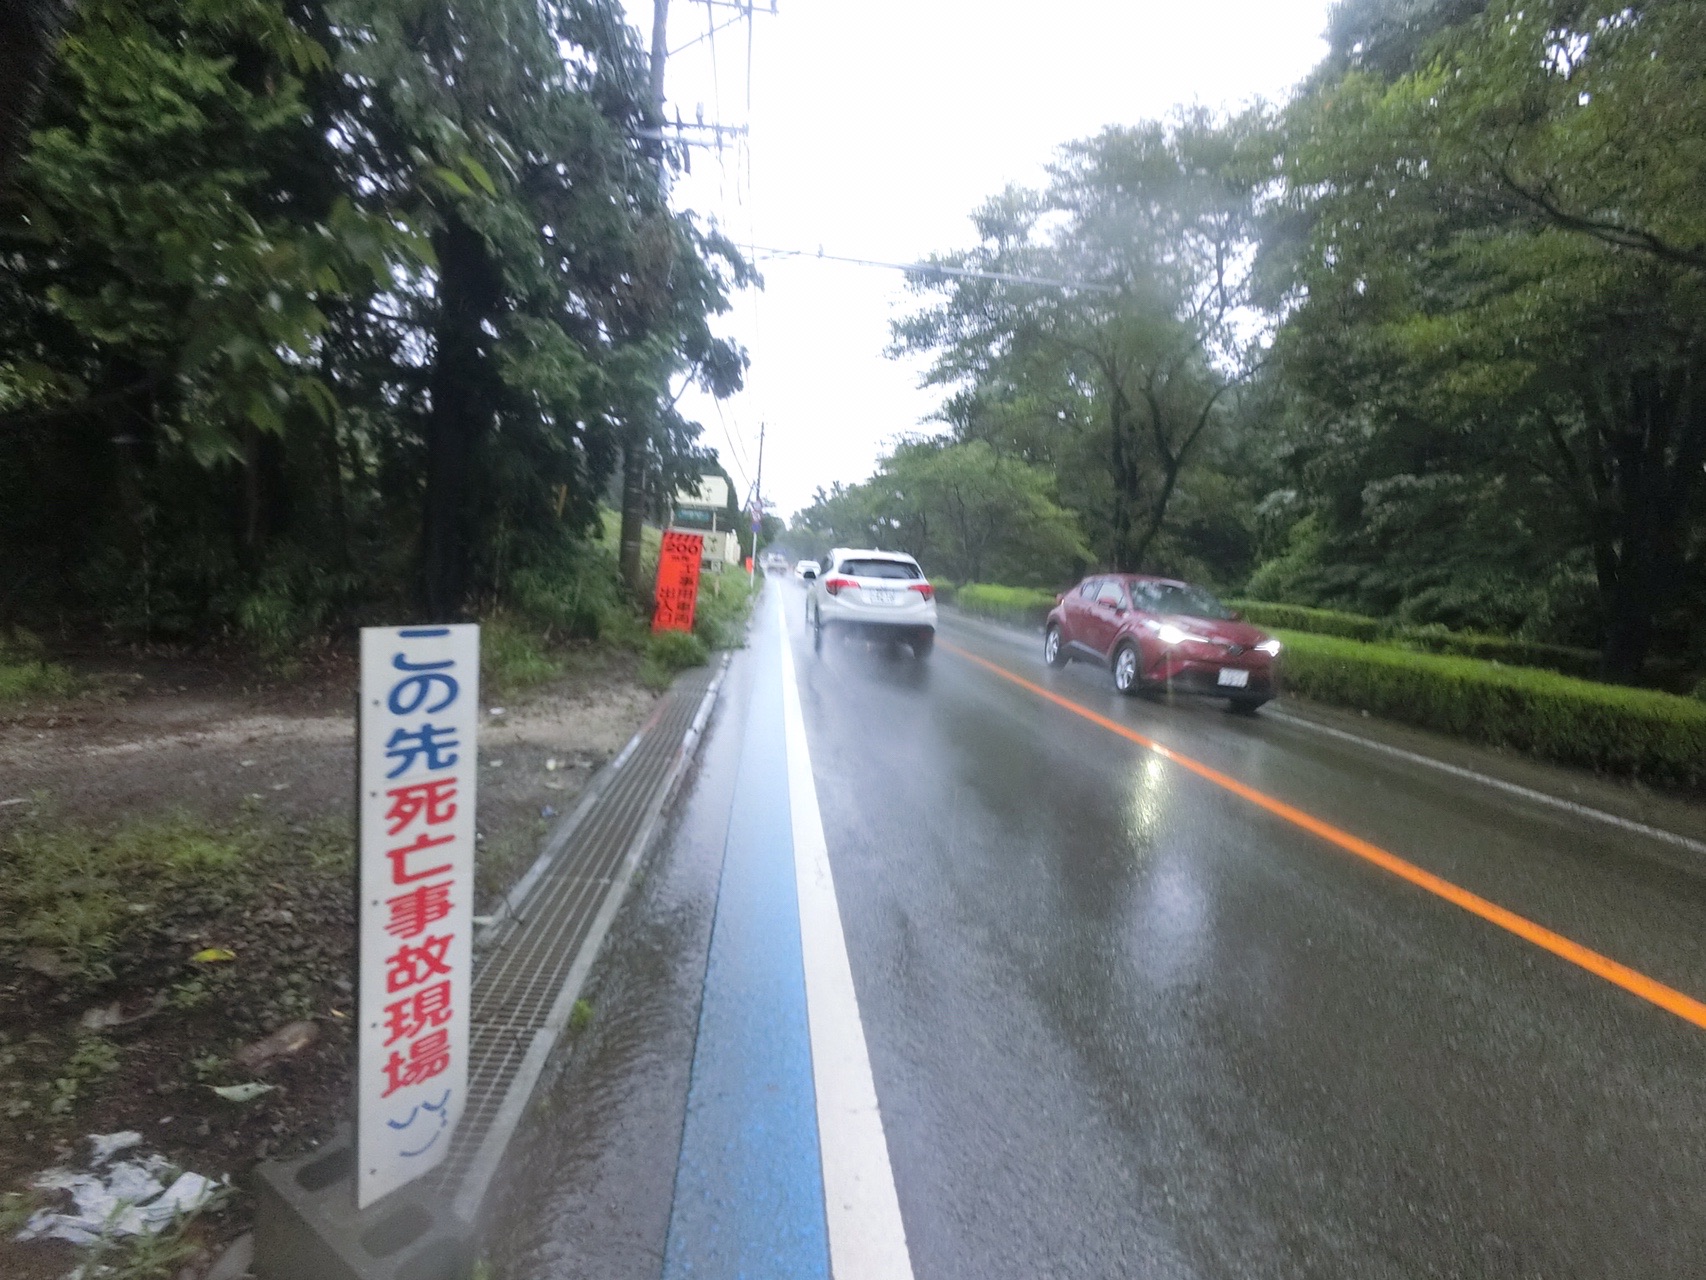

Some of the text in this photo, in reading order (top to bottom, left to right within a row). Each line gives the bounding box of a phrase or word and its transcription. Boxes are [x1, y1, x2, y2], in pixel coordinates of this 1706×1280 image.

[380, 628, 460, 1100] この先死亡事故現場
